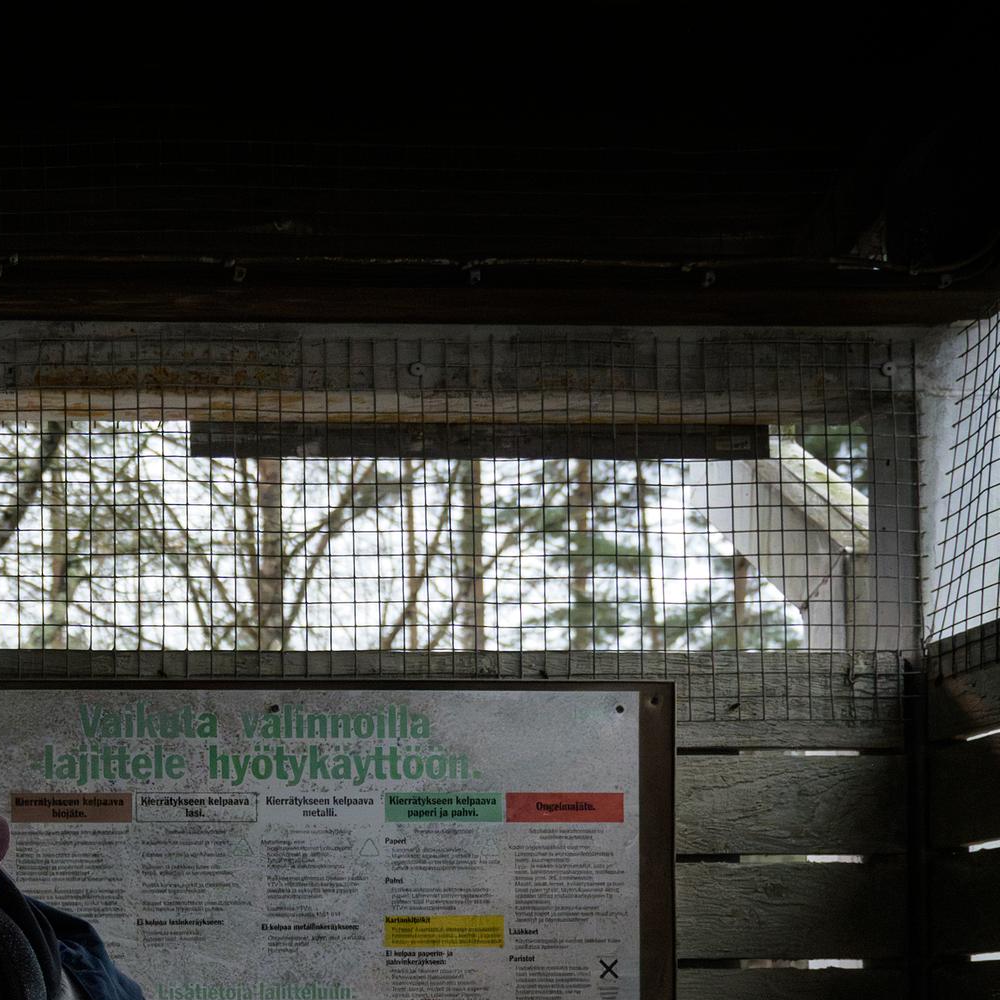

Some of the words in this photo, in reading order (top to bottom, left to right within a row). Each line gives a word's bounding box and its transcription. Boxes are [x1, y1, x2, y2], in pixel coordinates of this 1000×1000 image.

[79, 703, 217, 738] Vaikuta
[241, 704, 429, 739] valinnoilla
[44, 744, 185, 786] lajittele
[141, 796, 205, 807] Kierrätykseen
[208, 796, 249, 807] kelpaava
[266, 796, 330, 807] Kierrätykseen
[333, 796, 374, 807] kelpaava
[389, 796, 453, 807] Kierrätykseen
[456, 796, 496, 807] kelpaava
[303, 808, 337, 817] metalli.
[407, 808, 437, 818] paperi
[439, 808, 448, 818] ja
[451, 808, 479, 818] pahvi.
